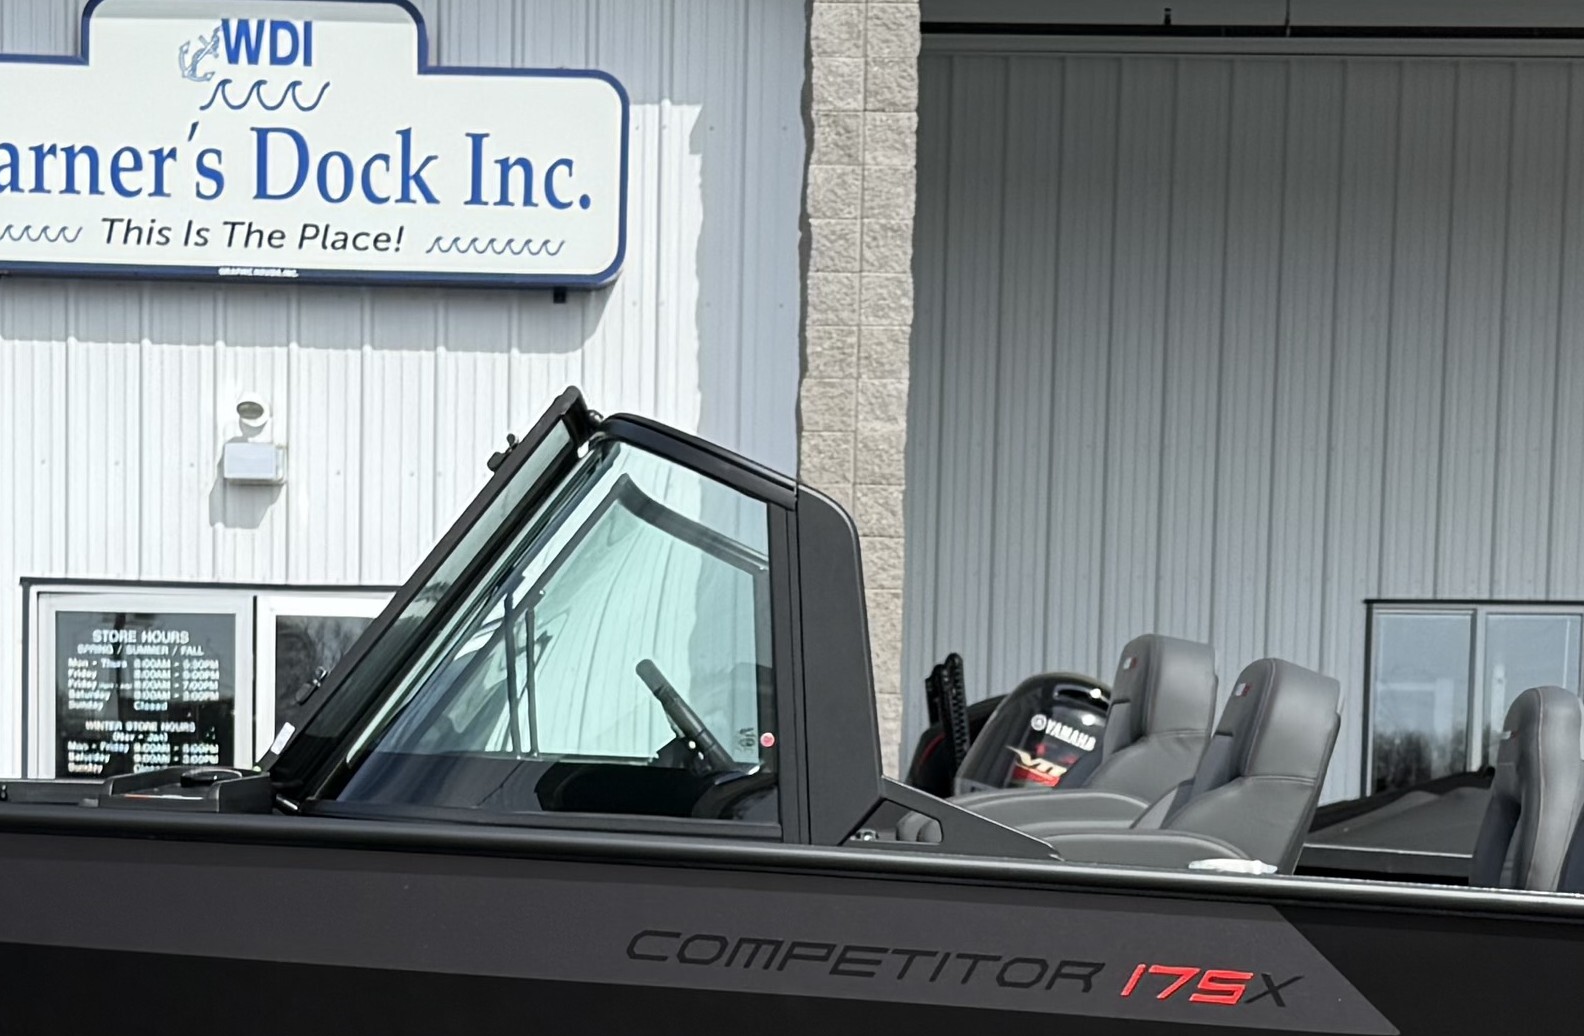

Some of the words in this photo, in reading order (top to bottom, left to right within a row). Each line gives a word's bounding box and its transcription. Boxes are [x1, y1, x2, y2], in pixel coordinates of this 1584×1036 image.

[220, 18, 313, 67] WDI
[249, 126, 441, 204] Dock
[462, 132, 592, 211] Inc.
[101, 217, 173, 247] This
[183, 219, 211, 248] Is
[222, 221, 287, 250] The
[297, 223, 405, 253] Place!
[92, 629, 137, 644] STORE
[141, 630, 190, 645] HOURS
[77, 643, 114, 655] SPRING
[125, 644, 169, 656] SUMMER
[180, 645, 205, 657] FALL
[67, 658, 89, 668] Mon
[68, 668, 97, 680] Friday
[68, 679, 97, 691] Friday
[68, 689, 111, 702] Saturday
[68, 700, 104, 712] Sunday
[133, 701, 168, 711] Closed
[85, 720, 123, 731] WINTER
[125, 721, 158, 732] STORE
[160, 721, 196, 733] HOURS
[1045, 718, 1097, 752] YAMAHA
[67, 740, 89, 751] Mon
[100, 741, 130, 754] Friday
[68, 751, 111, 764] Saturday
[625, 929, 1106, 993] COMPETITOR
